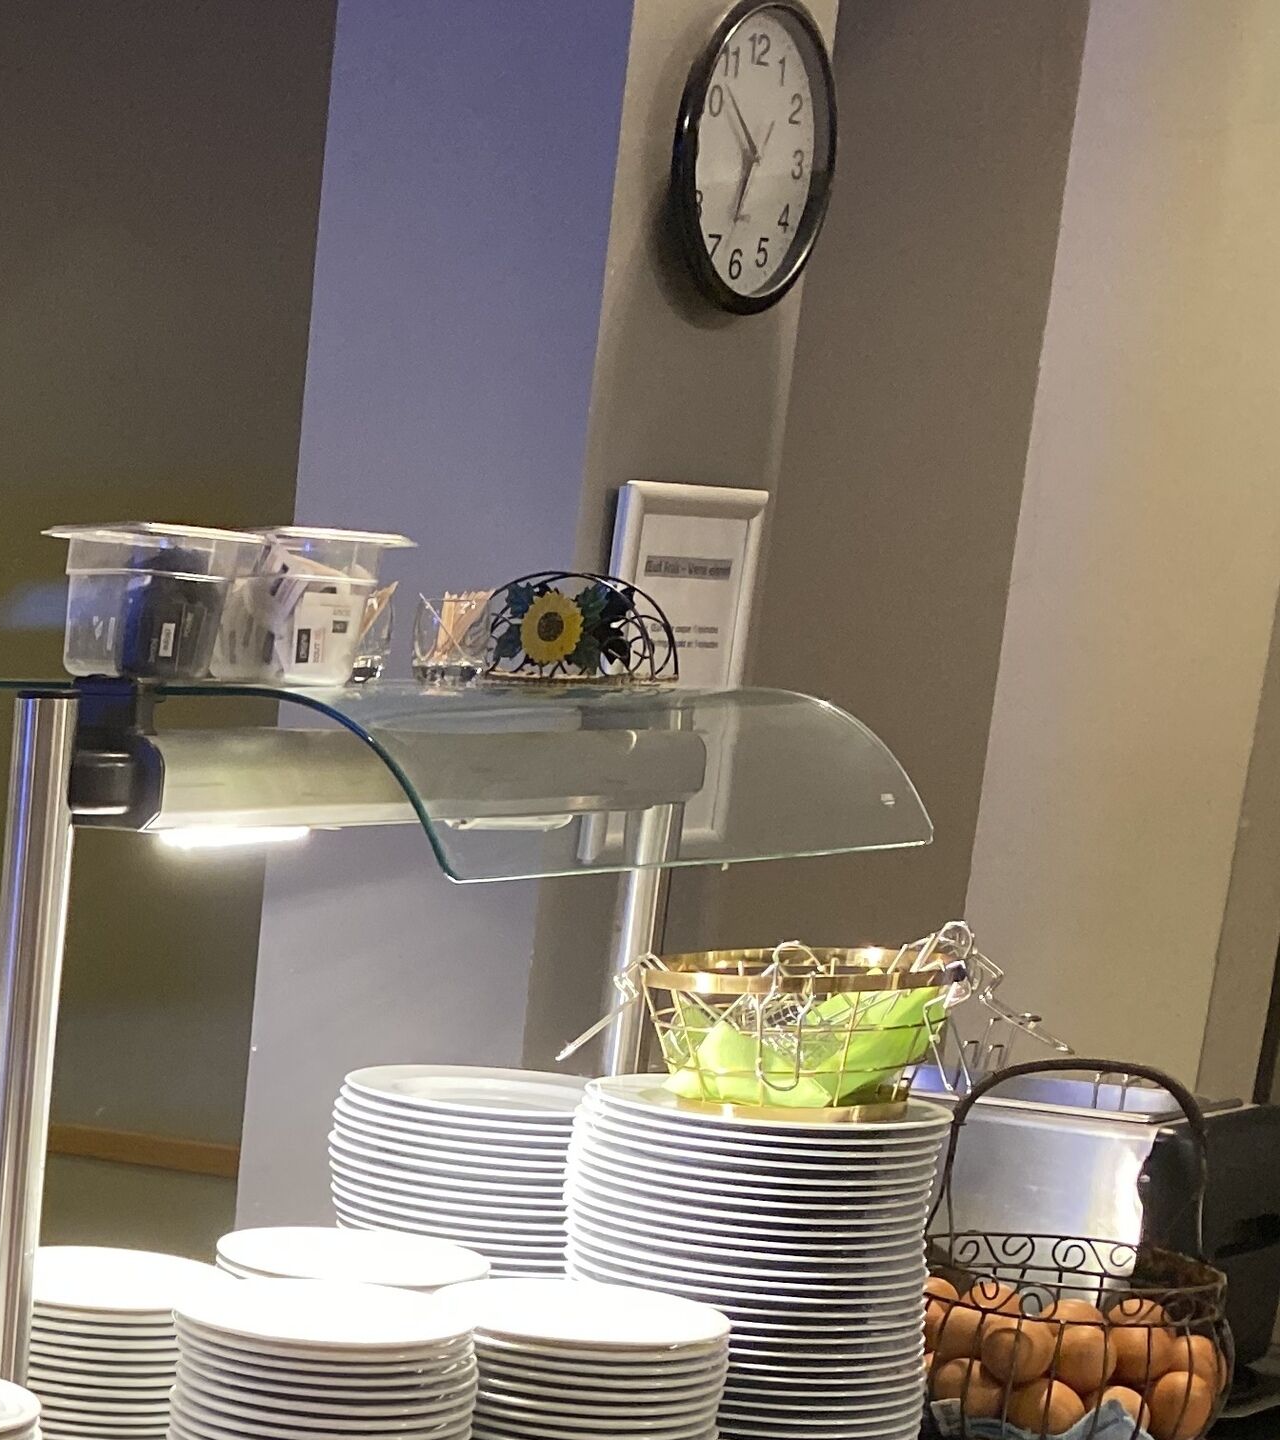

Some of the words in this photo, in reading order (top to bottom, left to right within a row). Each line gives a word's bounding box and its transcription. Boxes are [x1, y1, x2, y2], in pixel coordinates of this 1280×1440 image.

[721, 44, 740, 78] 11
[748, 32, 771, 67] 12
[778, 56, 786, 86] 1
[788, 93, 803, 125] 2
[791, 149, 804, 180] 3
[777, 203, 790, 233] 4
[729, 248, 743, 280] 6
[755, 237, 769, 267] 5
